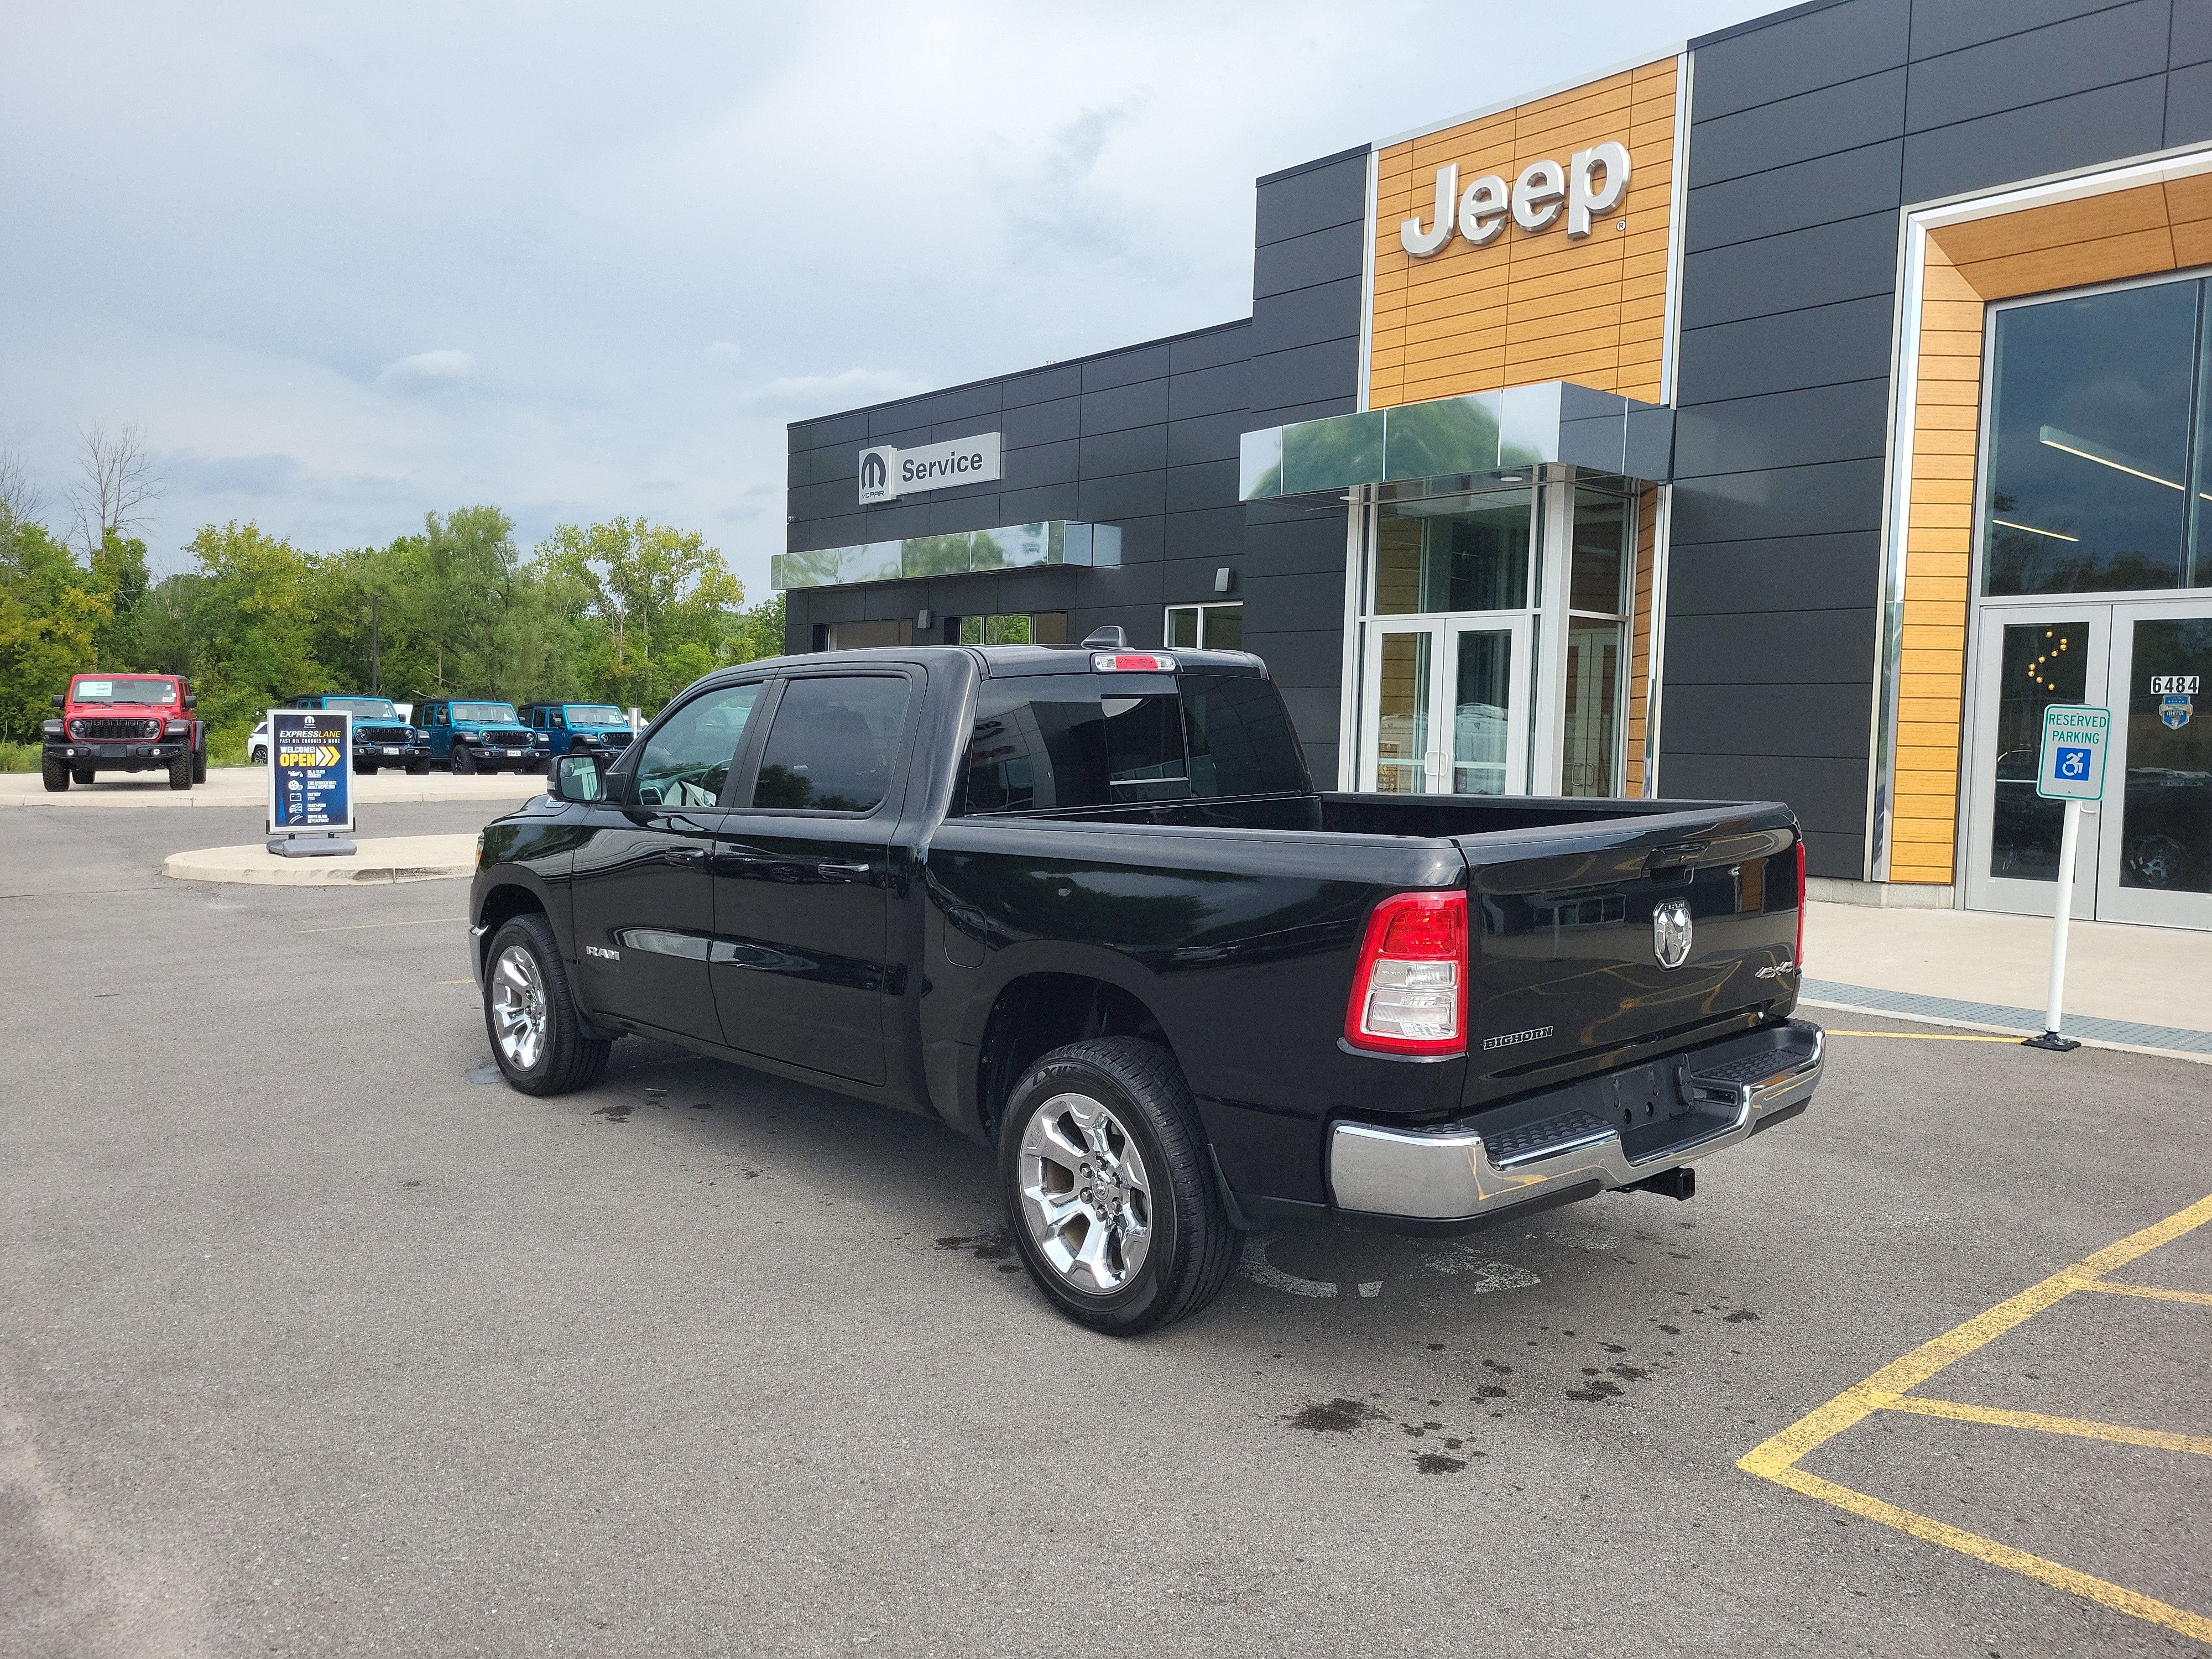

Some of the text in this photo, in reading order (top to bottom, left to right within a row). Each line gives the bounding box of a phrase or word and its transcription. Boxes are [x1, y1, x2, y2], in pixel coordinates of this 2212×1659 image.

[1401, 141, 1631, 258] Jeep
[902, 451, 983, 482] Service
[861, 490, 885, 498] MOPAR
[2152, 676, 2198, 693] 6484
[2048, 714, 2106, 728] RESERVED
[2052, 731, 2100, 744] PARKING
[280, 753, 316, 766] OPEN
[586, 946, 620, 961] RAM
[1483, 1026, 1553, 1050] BIGHORN
